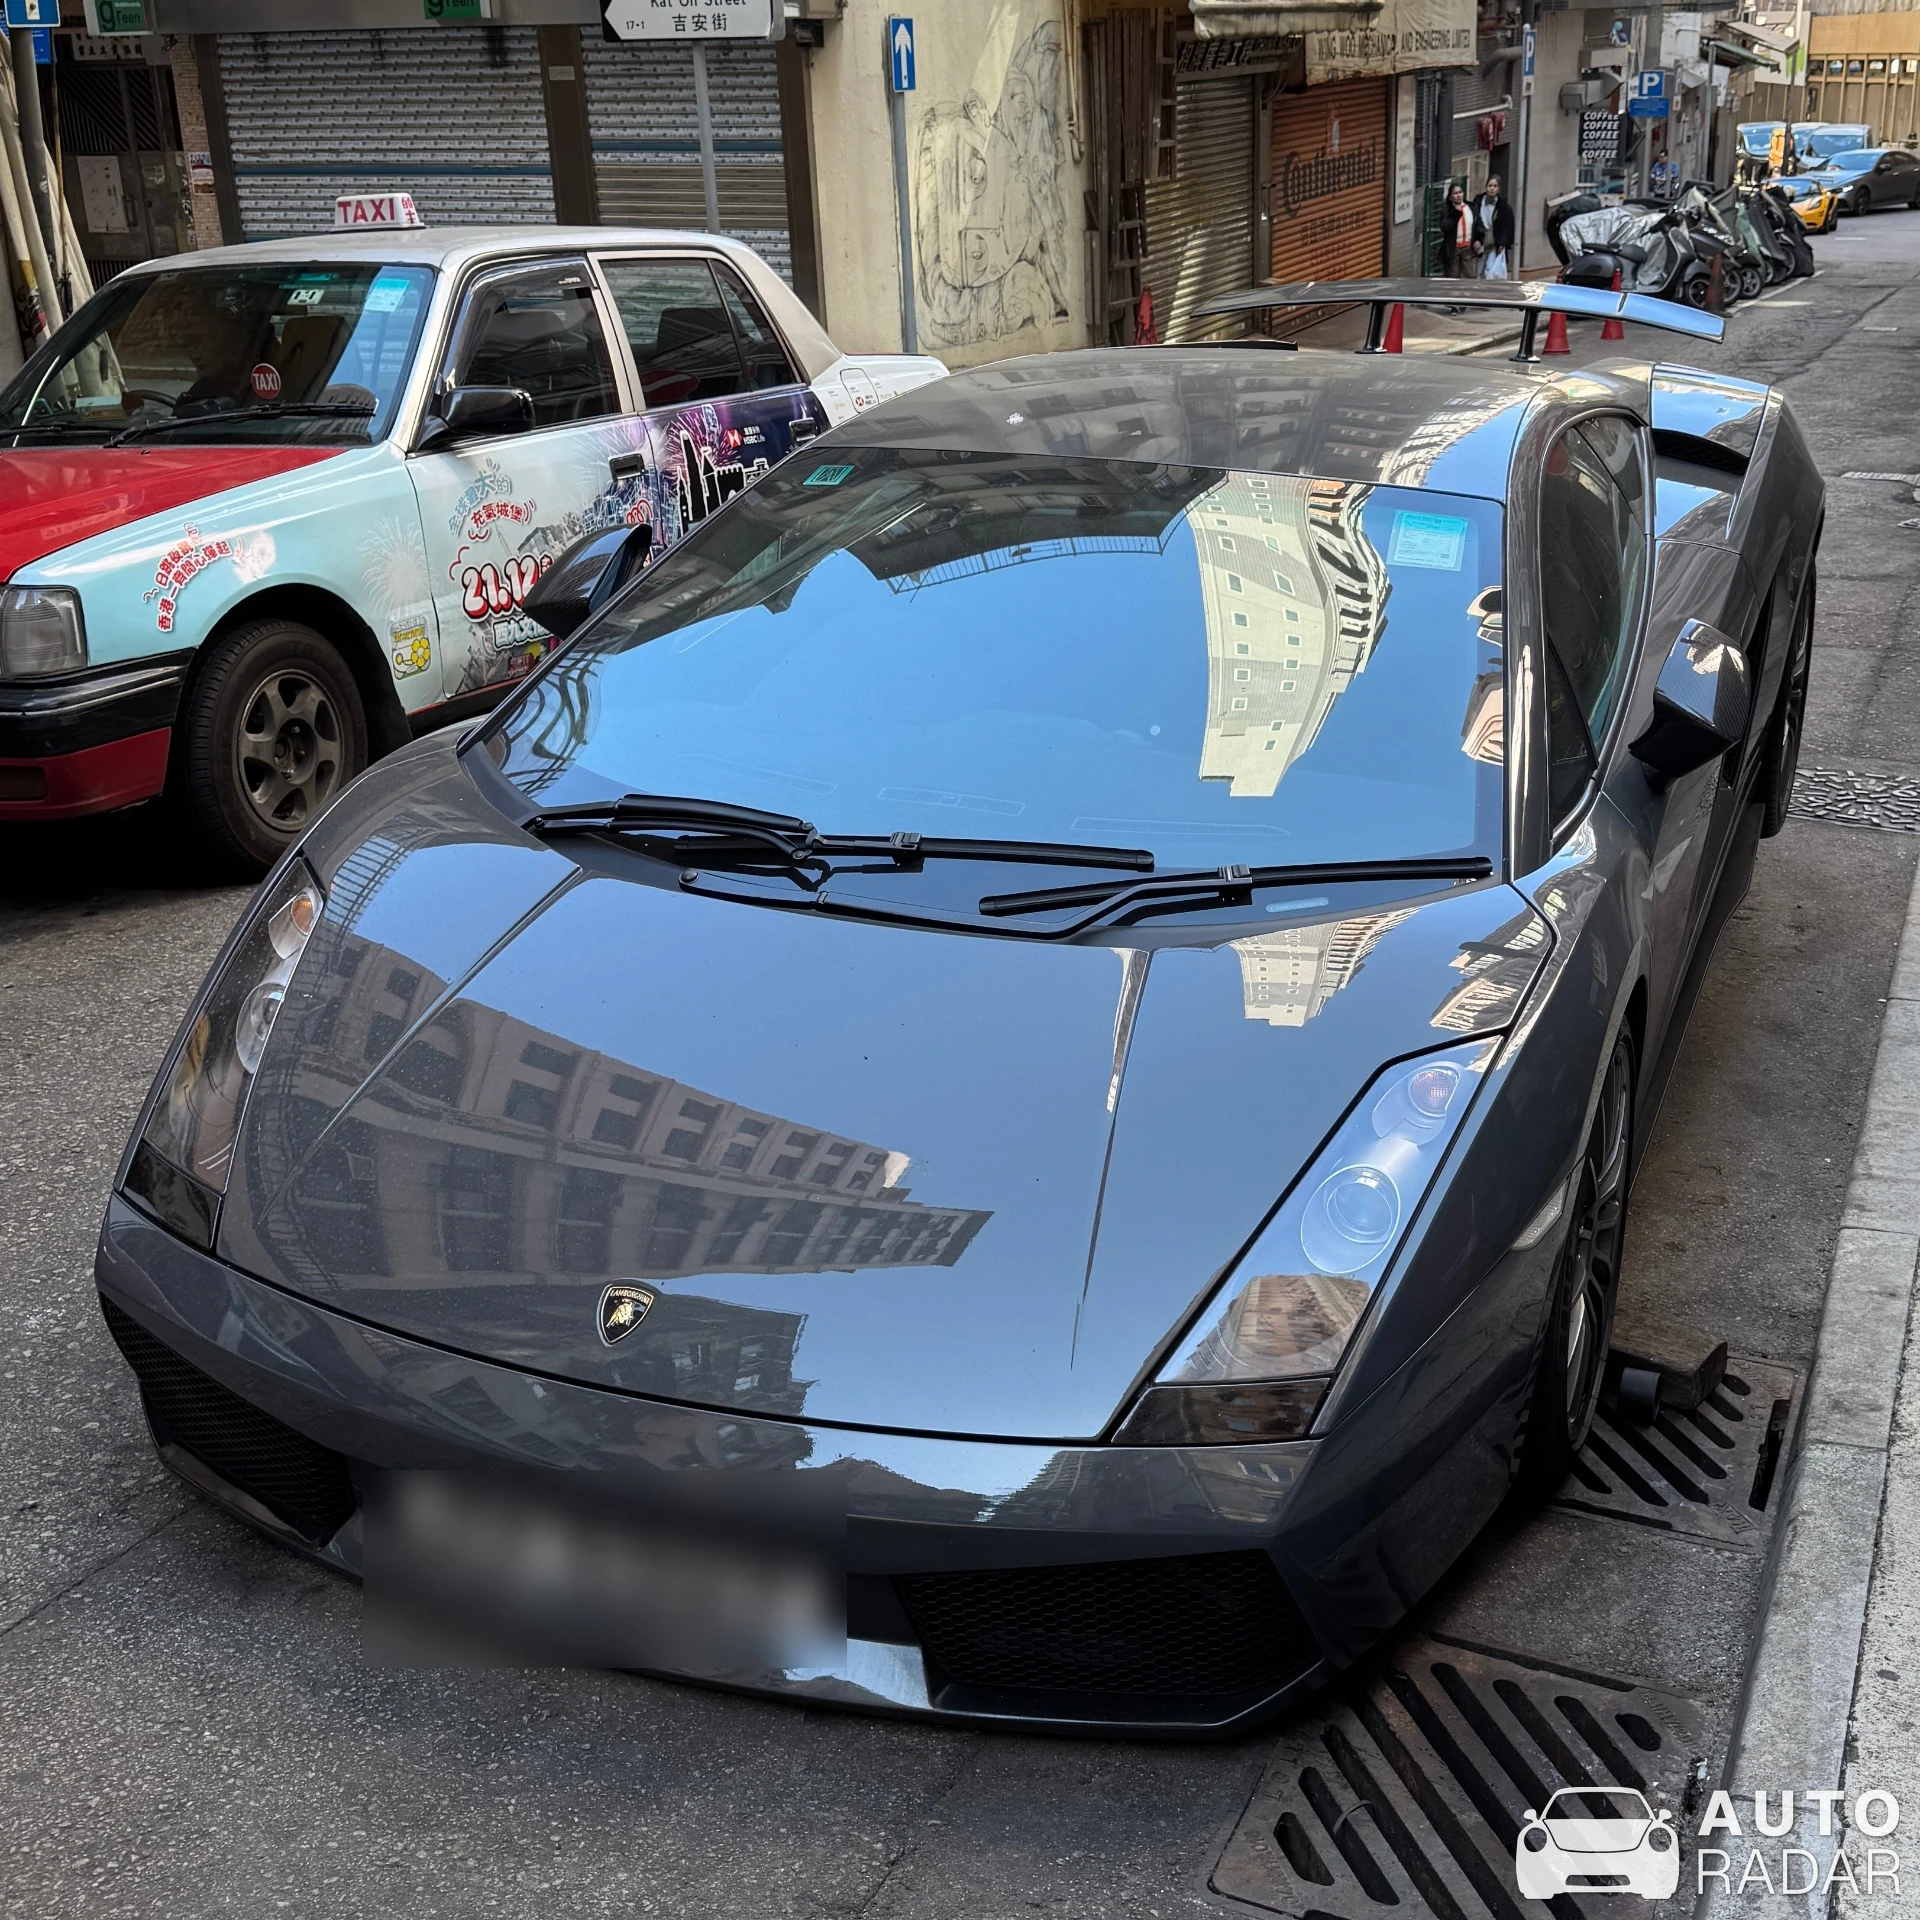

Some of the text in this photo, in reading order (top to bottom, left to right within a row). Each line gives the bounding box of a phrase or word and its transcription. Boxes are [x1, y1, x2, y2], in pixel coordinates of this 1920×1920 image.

[99, 0, 141, 31] green
[672, 13, 728, 33] 吉安街
[1526, 35, 1535, 72] P
[1641, 72, 1660, 95] P
[1582, 131, 1619, 139] COFFEE
[1583, 121, 1620, 130] COFFEE
[1581, 149, 1618, 159] COFFEE
[1283, 136, 1378, 218] Continental
[337, 198, 396, 224] TAXI
[401, 197, 416, 224] 的士
[252, 373, 279, 391] TAXI
[448, 469, 511, 536] 全球最大的
[470, 502, 524, 528] 充氣城堡
[610, 1288, 651, 1306] LAMBORGHINI
